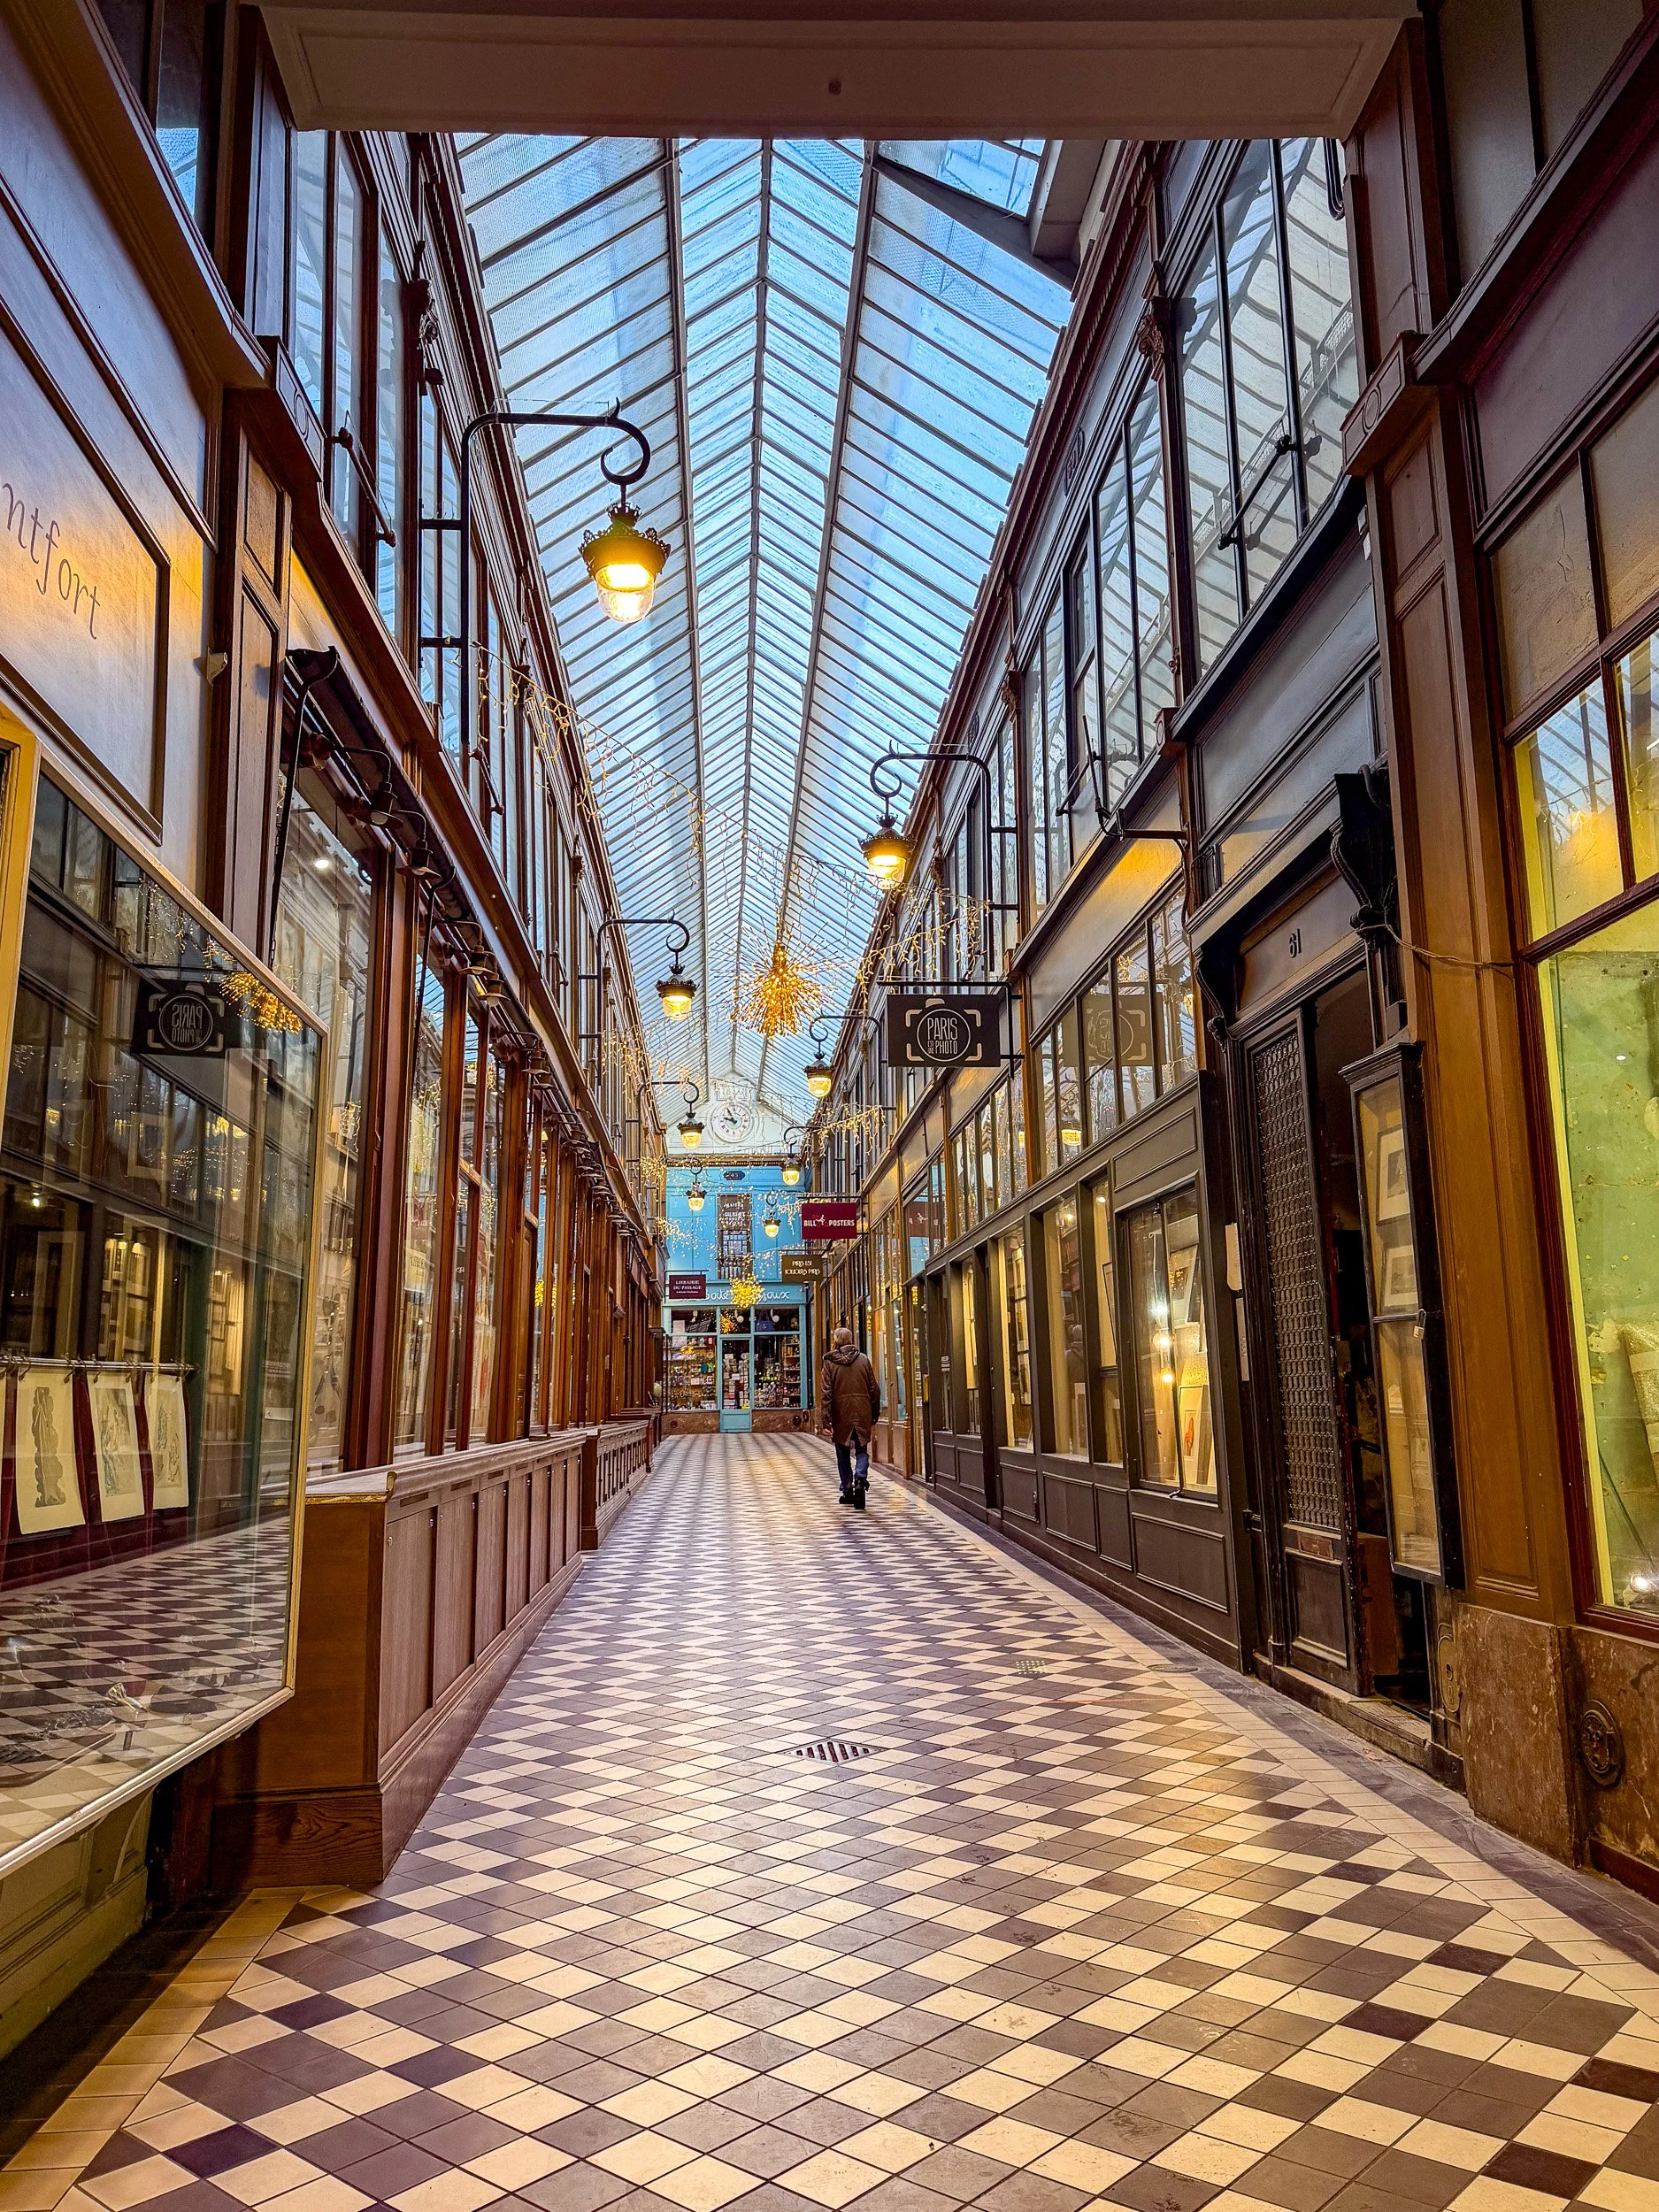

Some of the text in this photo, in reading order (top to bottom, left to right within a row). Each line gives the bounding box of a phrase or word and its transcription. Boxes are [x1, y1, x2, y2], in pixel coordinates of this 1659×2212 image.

[1289, 928, 1302, 958] 61
[927, 1018, 957, 1041] PARIS
[934, 1040, 957, 1054] PHOTO
